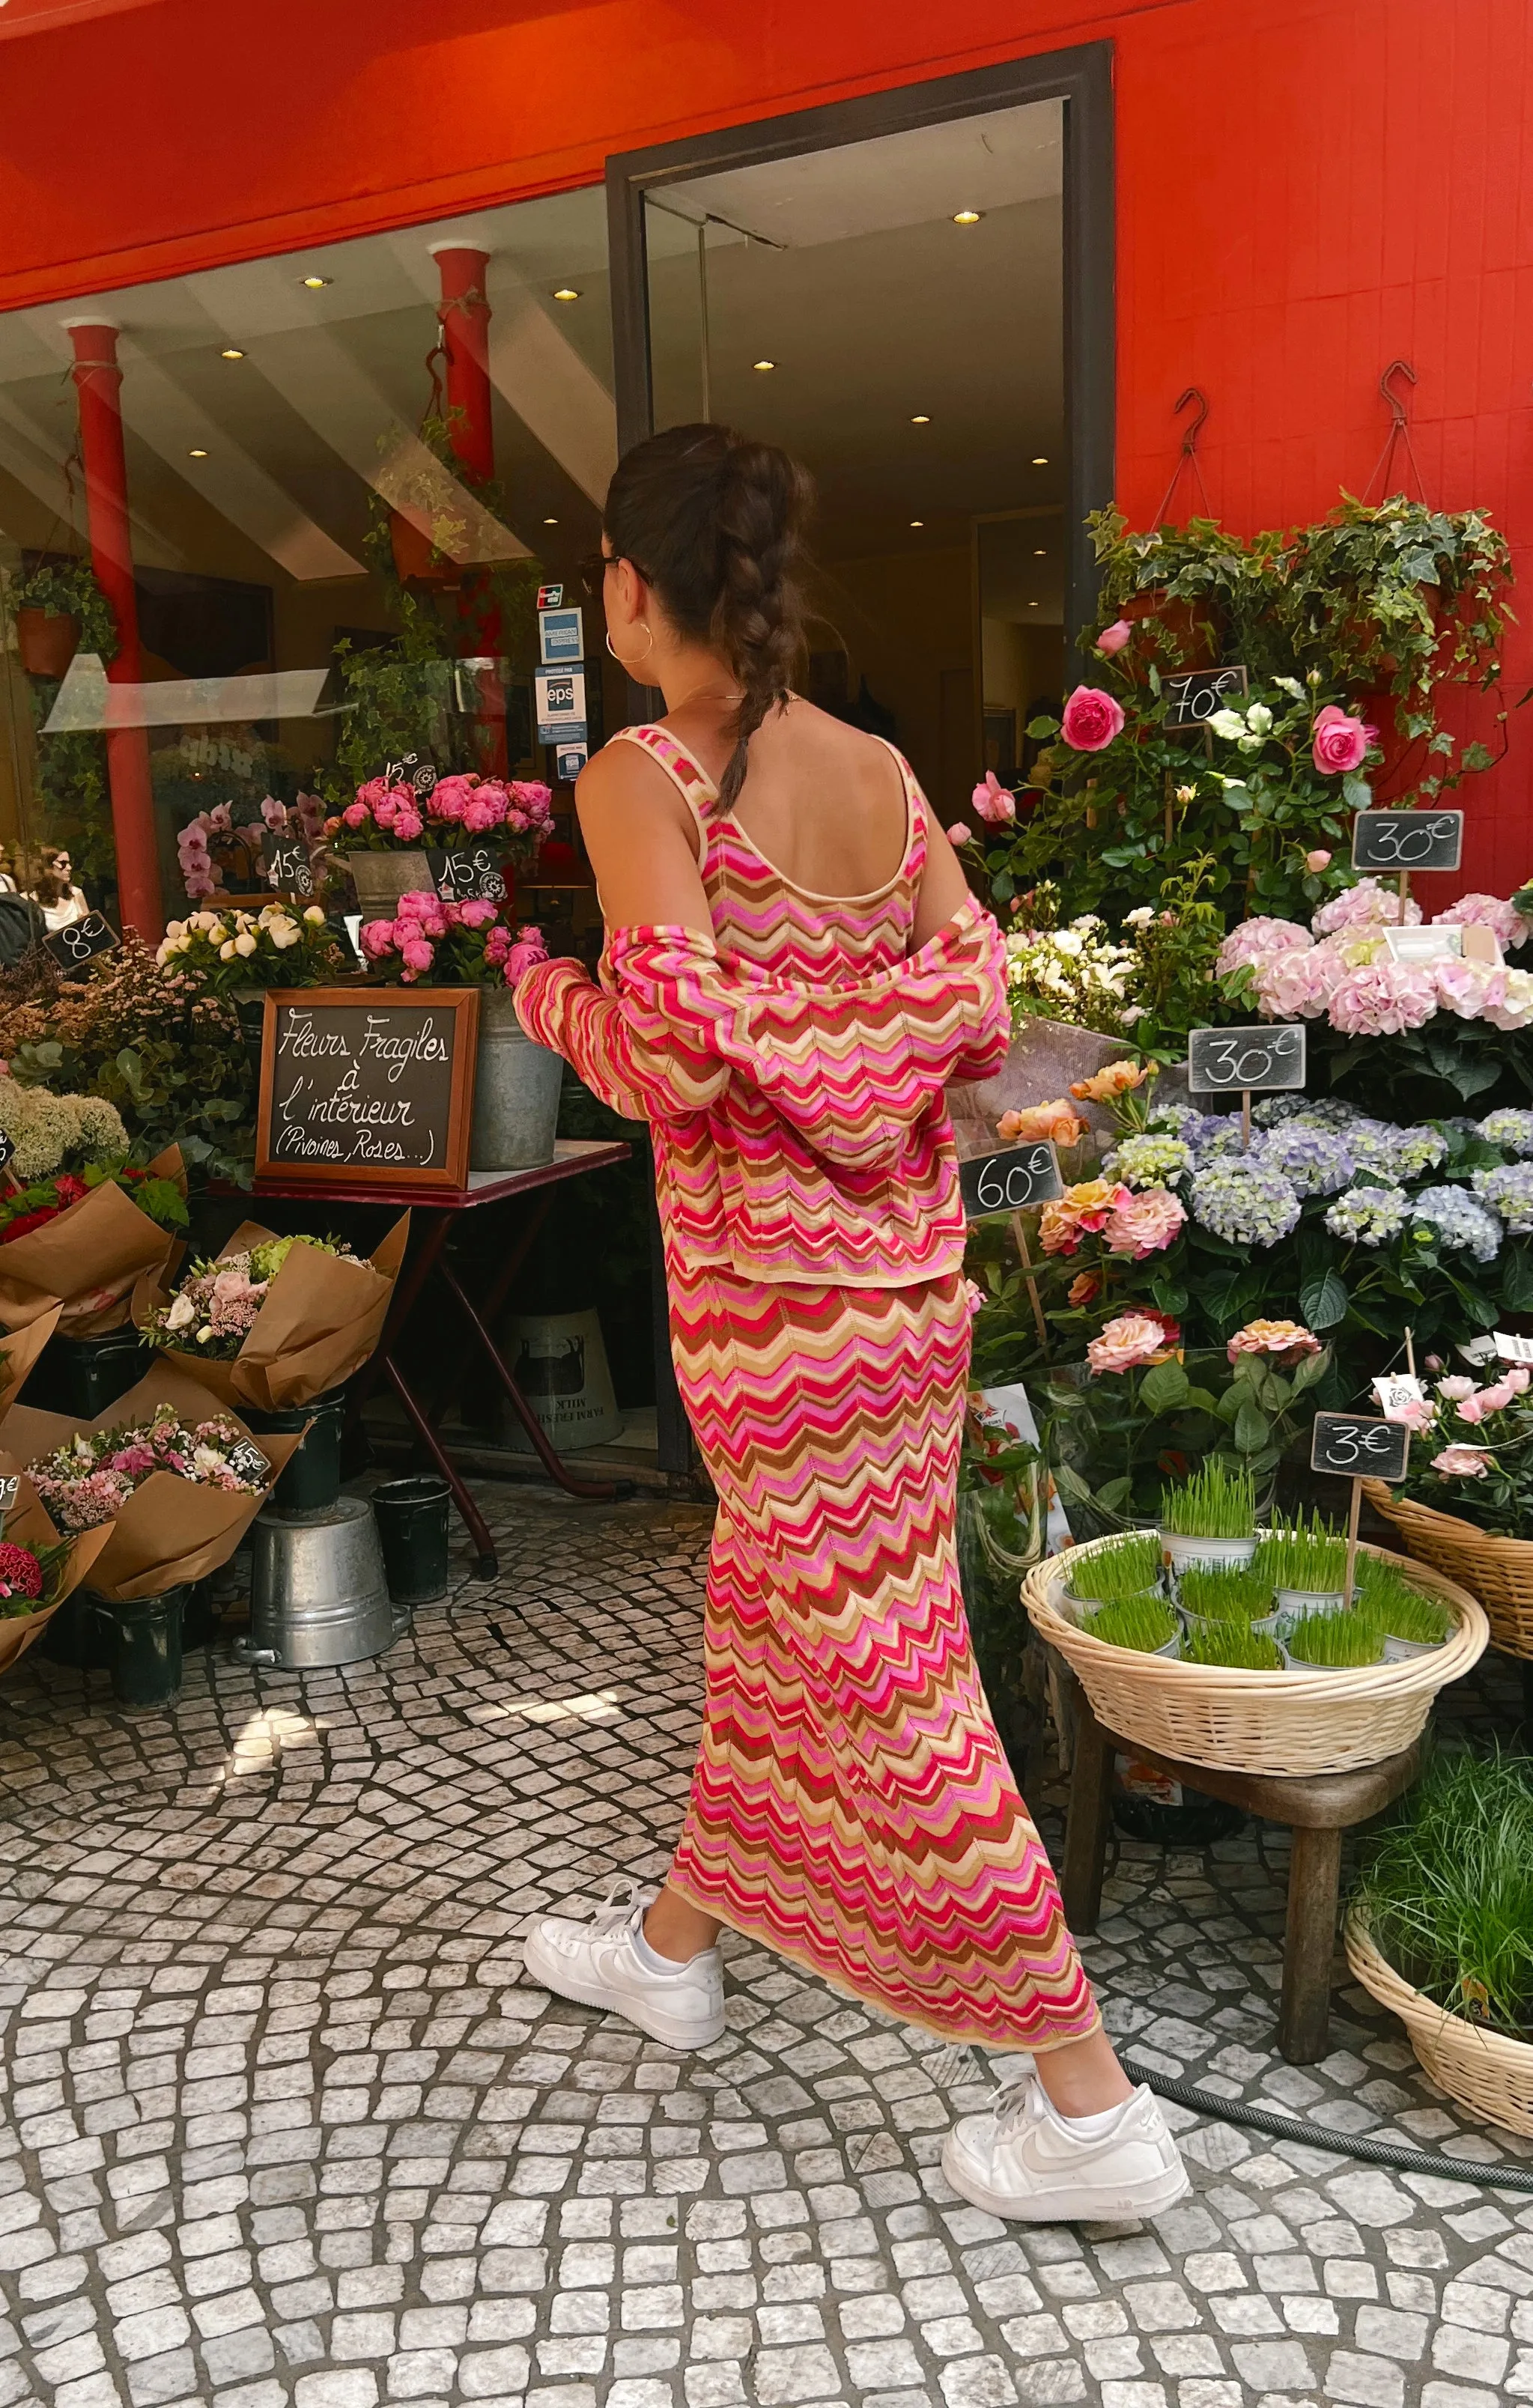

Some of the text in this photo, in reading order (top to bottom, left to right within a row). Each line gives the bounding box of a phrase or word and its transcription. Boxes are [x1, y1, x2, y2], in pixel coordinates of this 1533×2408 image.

[544, 628, 577, 638] AMERICAN
[552, 637, 580, 646] EXPRESS
[547, 687, 574, 704] eps
[1169, 671, 1242, 723] 70€
[1367, 815, 1456, 861] 30€
[270, 845, 306, 878] 15€
[438, 850, 491, 885] 15€
[62, 917, 105, 959] 8€
[279, 1008, 449, 1083] Fleurs Fragiles
[1205, 1028, 1298, 1083] 30€
[337, 1059, 360, 1091] à
[977, 1146, 1052, 1208] 60€
[557, 1397, 587, 1409] MILK
[576, 1407, 604, 1420] FARM
[1326, 1425, 1391, 1464] 3€
